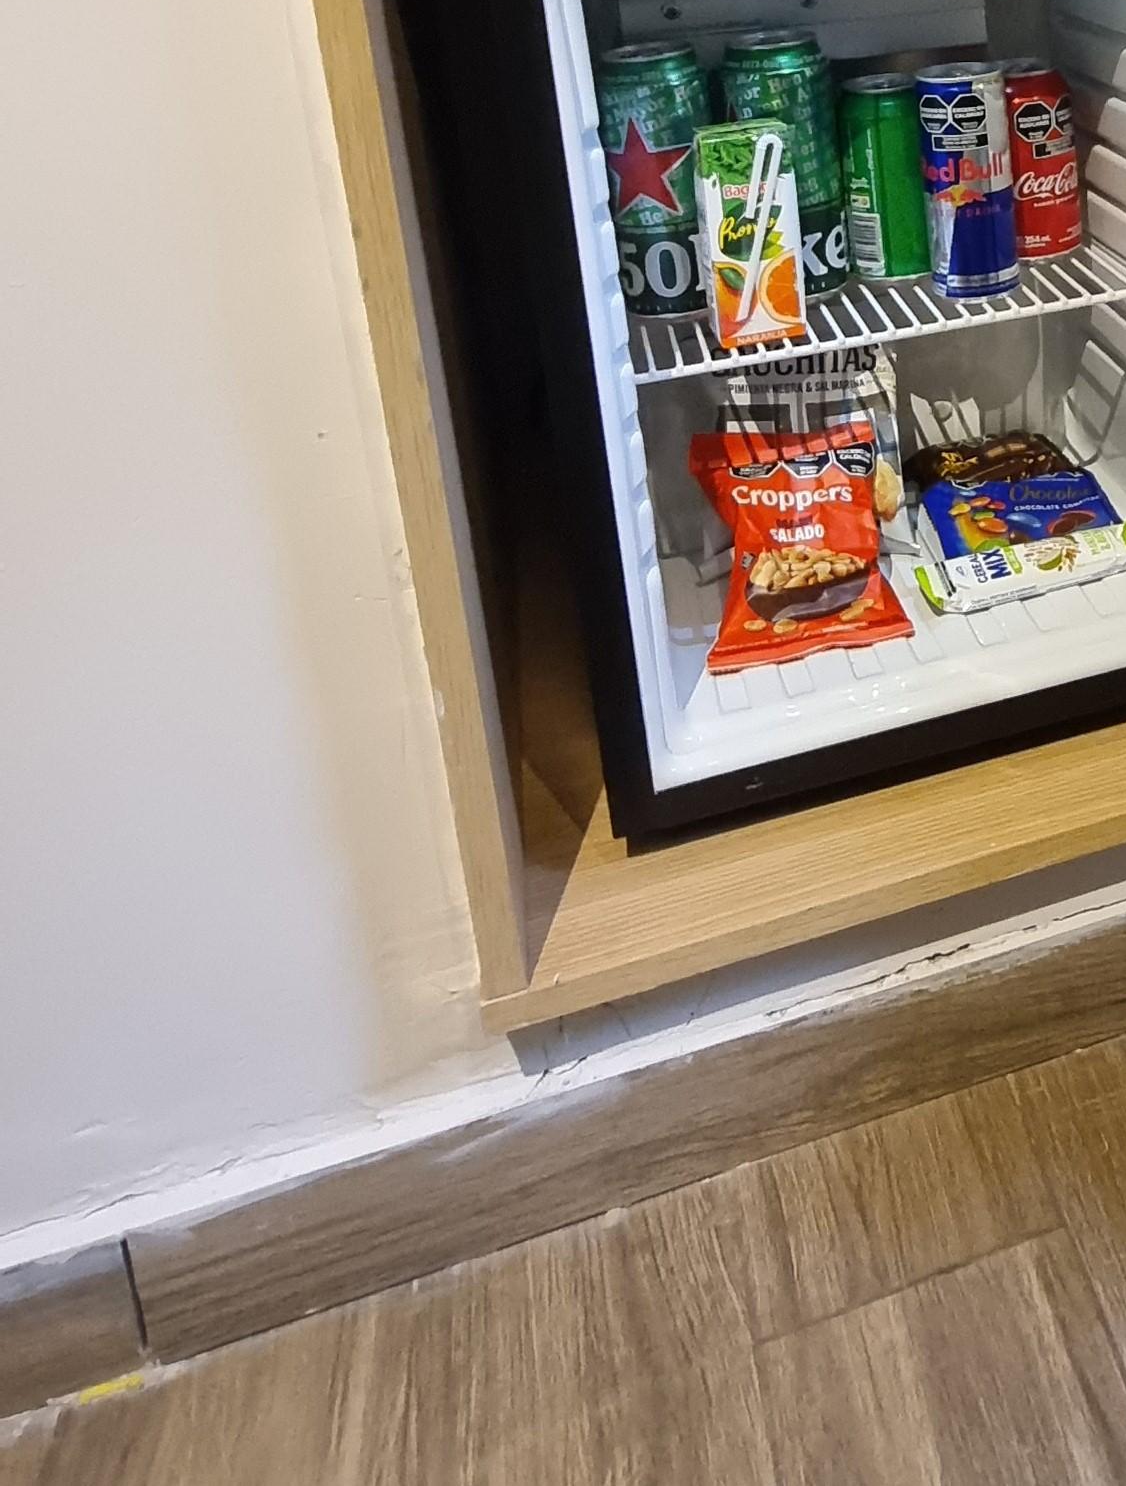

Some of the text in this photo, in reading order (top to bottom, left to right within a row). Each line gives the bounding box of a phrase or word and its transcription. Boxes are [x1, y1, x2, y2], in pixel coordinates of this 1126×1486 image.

[959, 152, 1003, 182] Bull
[736, 329, 788, 346] NARANJA
[732, 485, 853, 512] Croppers
[769, 523, 825, 543] SALADO
[983, 548, 1012, 580] MIX
